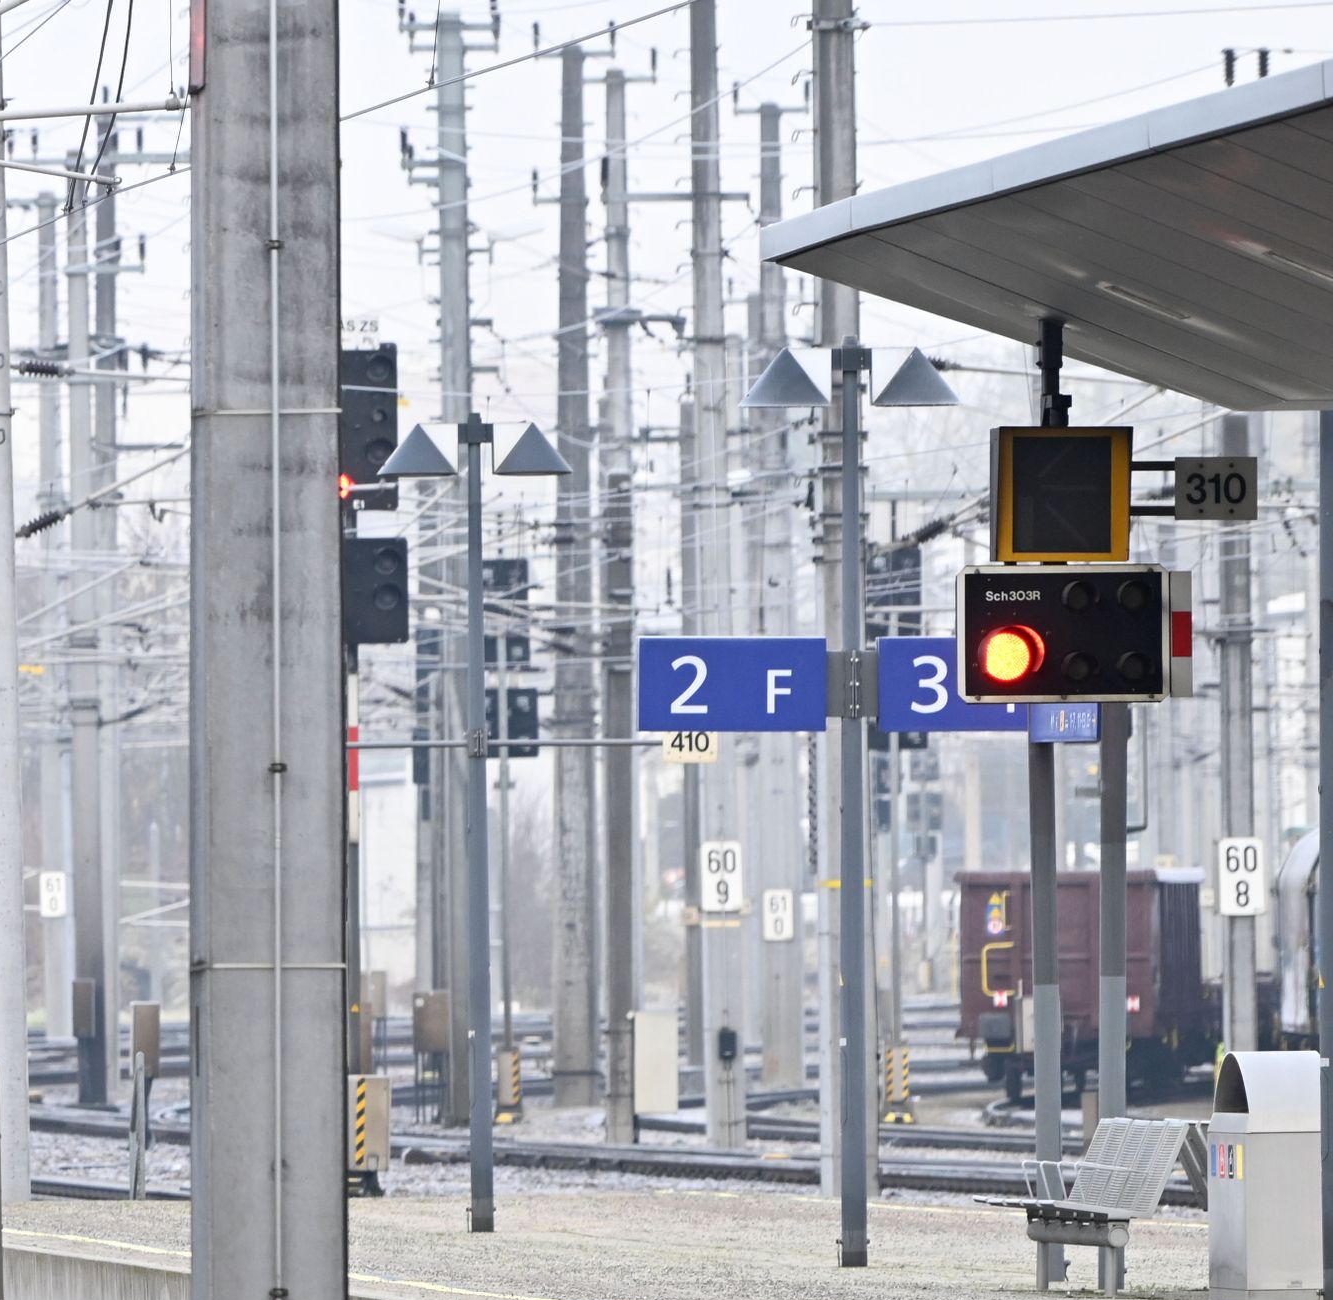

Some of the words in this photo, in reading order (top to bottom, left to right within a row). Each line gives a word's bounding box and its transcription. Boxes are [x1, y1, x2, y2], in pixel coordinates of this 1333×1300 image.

[1186, 473, 1246, 505] 310
[670, 655, 709, 714] 2
[767, 669, 793, 714] F
[910, 655, 949, 714] 3
[671, 732, 710, 752] 410
[708, 849, 736, 874] 60
[1226, 845, 1257, 873] 60
[716, 880, 729, 905] 9
[769, 895, 787, 914] 61
[1235, 880, 1249, 907] 8
[774, 917, 784, 935] 0
